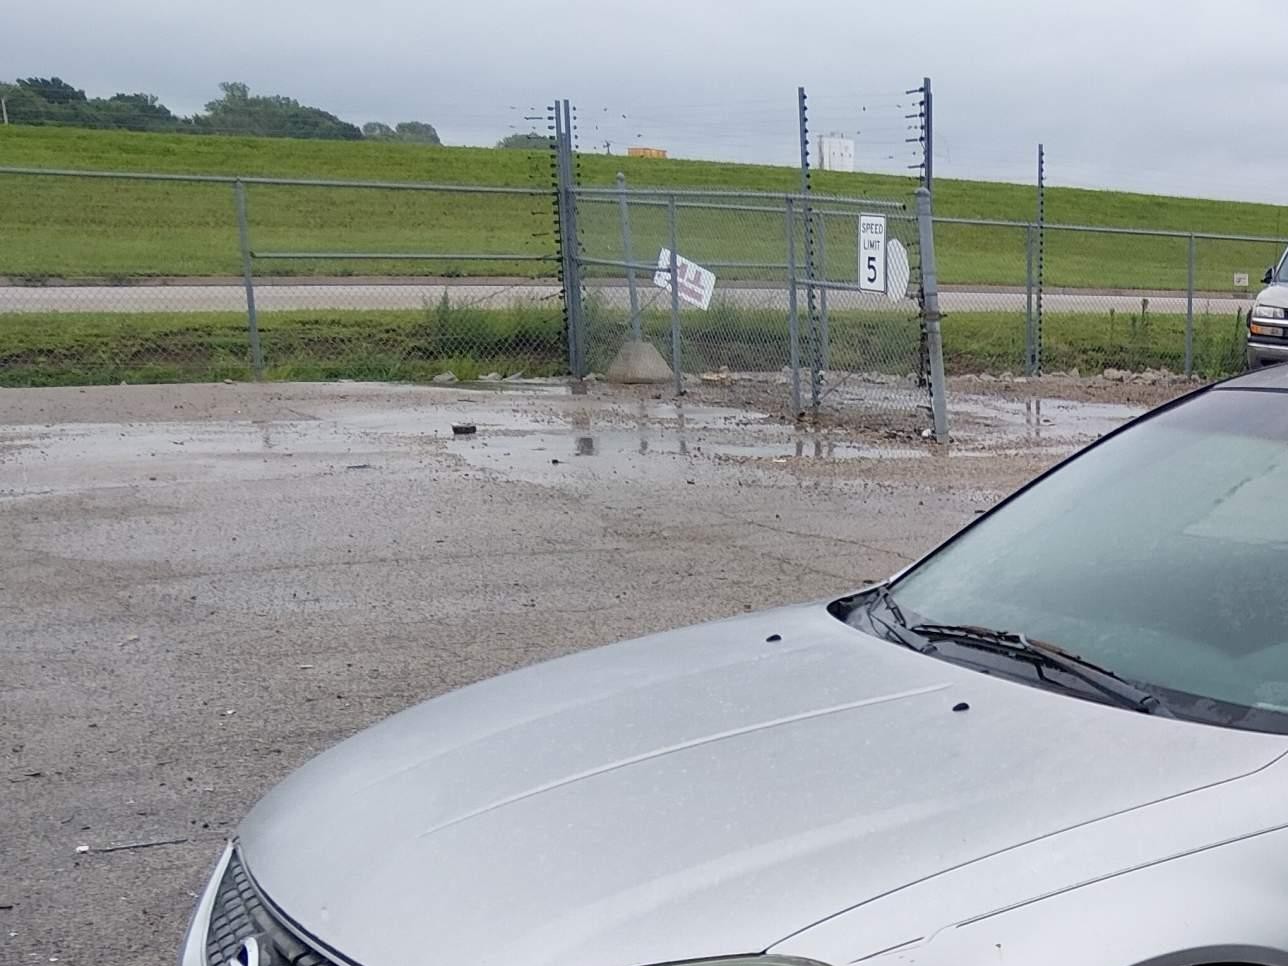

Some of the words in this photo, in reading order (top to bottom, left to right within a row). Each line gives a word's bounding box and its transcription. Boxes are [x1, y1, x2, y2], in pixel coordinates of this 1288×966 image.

[861, 222, 884, 235] SPEED
[863, 239, 881, 251] LIMIT
[866, 255, 877, 283] 5
